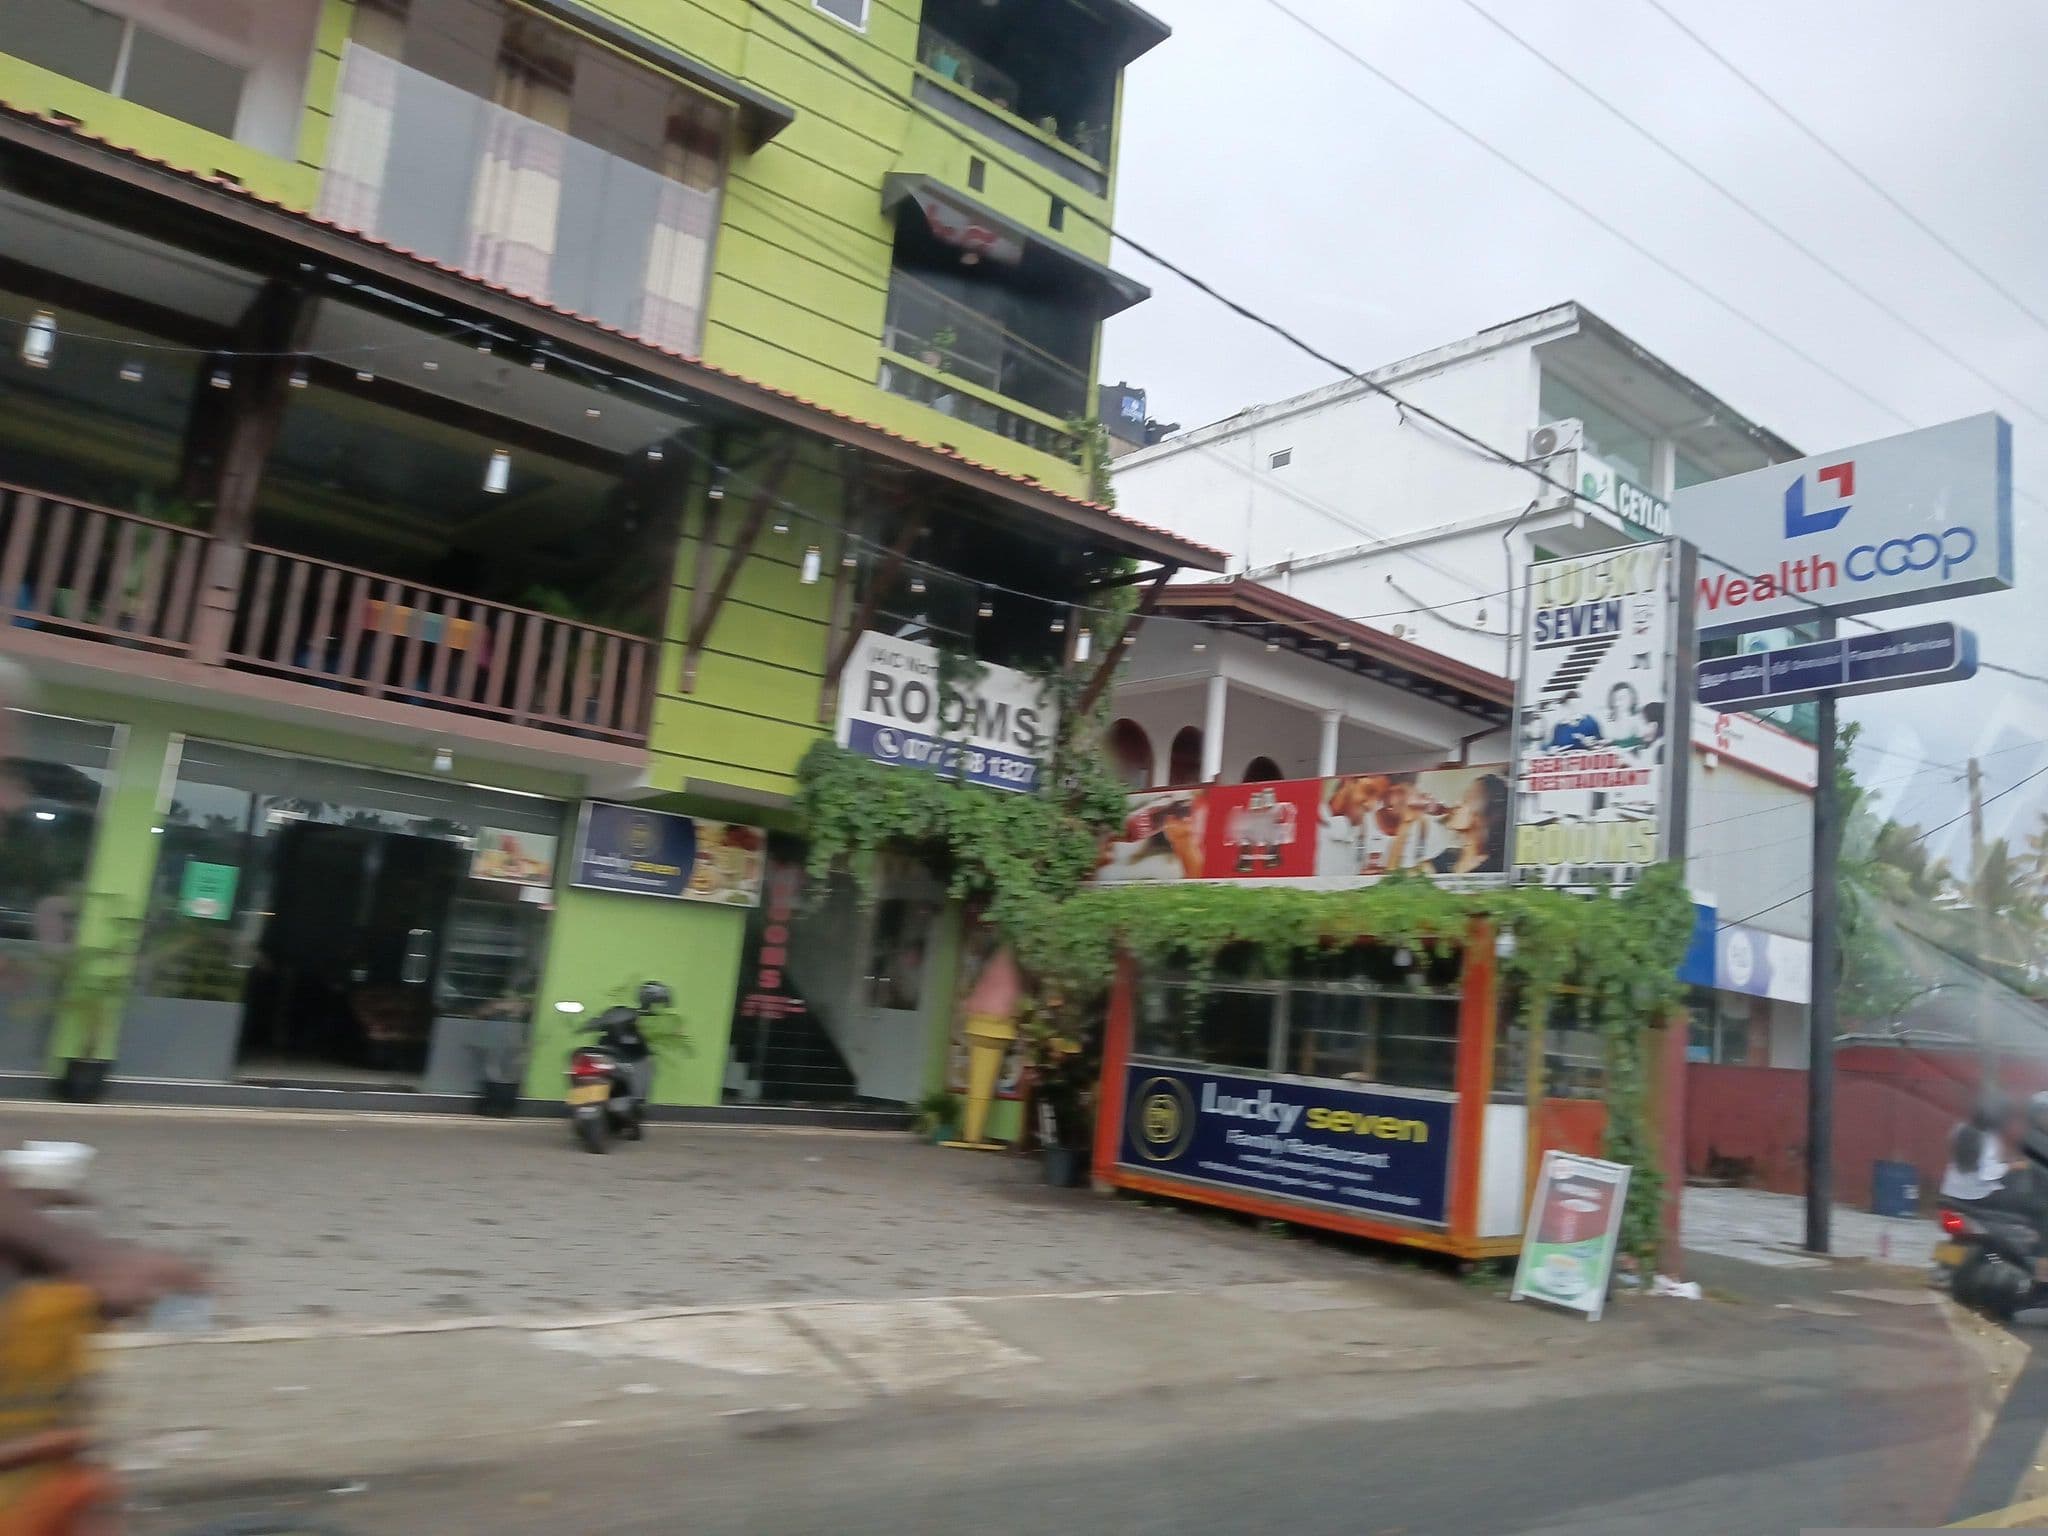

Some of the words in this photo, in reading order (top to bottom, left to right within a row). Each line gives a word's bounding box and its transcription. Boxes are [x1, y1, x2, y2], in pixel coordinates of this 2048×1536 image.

[1533, 549, 1660, 609] LUCKY
[1697, 554, 1838, 610] Wealth
[1845, 526, 1977, 581] coop
[1534, 599, 1622, 642] SEVEN
[864, 670, 1043, 748] ROOMS
[987, 756, 1036, 784] 1327
[1529, 769, 1651, 792] RESTAURANT
[1516, 820, 1661, 866] ROOMS
[1201, 1082, 1304, 1134] Lucky
[1305, 1106, 1429, 1144] seven
